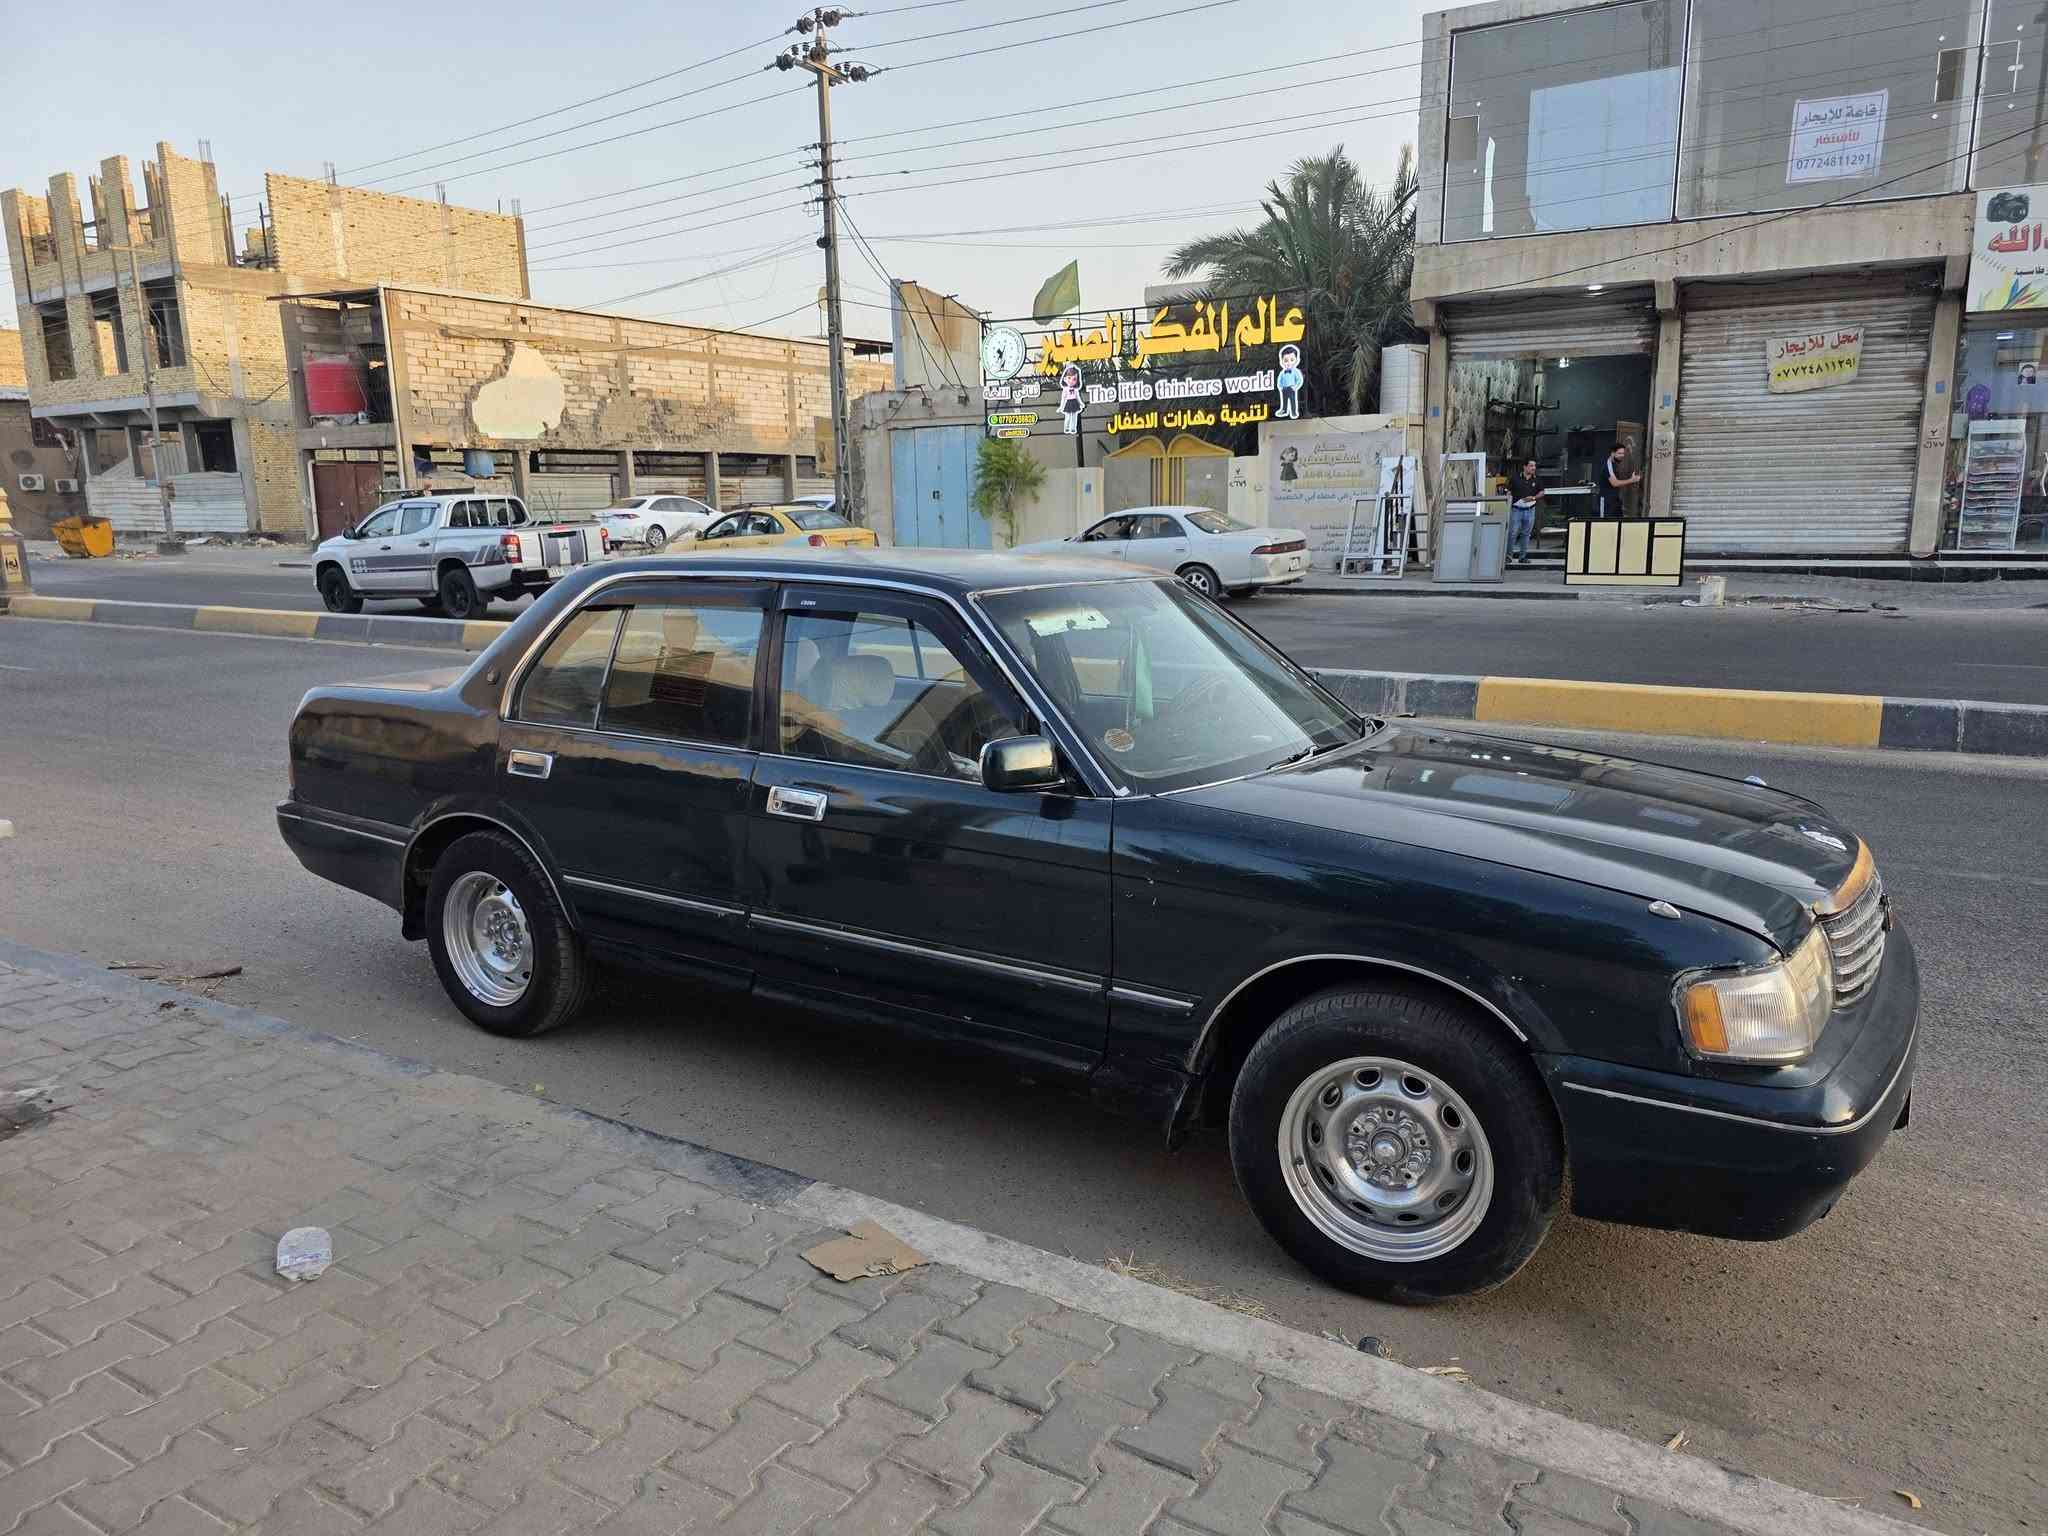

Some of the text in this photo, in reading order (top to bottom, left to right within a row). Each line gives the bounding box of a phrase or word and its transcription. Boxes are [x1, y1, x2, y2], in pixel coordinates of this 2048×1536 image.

[1845, 103, 1878, 118] قاعة
[1796, 153, 1871, 170] 07724811291
[1037, 312, 1123, 376] الصغير
[1129, 299, 1228, 369] المفكر
[1234, 294, 1306, 363] عالم
[1830, 331, 1860, 350] محل
[1086, 370, 1275, 404] The little thinkers world
[1106, 403, 1271, 435] لتنمية مهارات الاطفال
